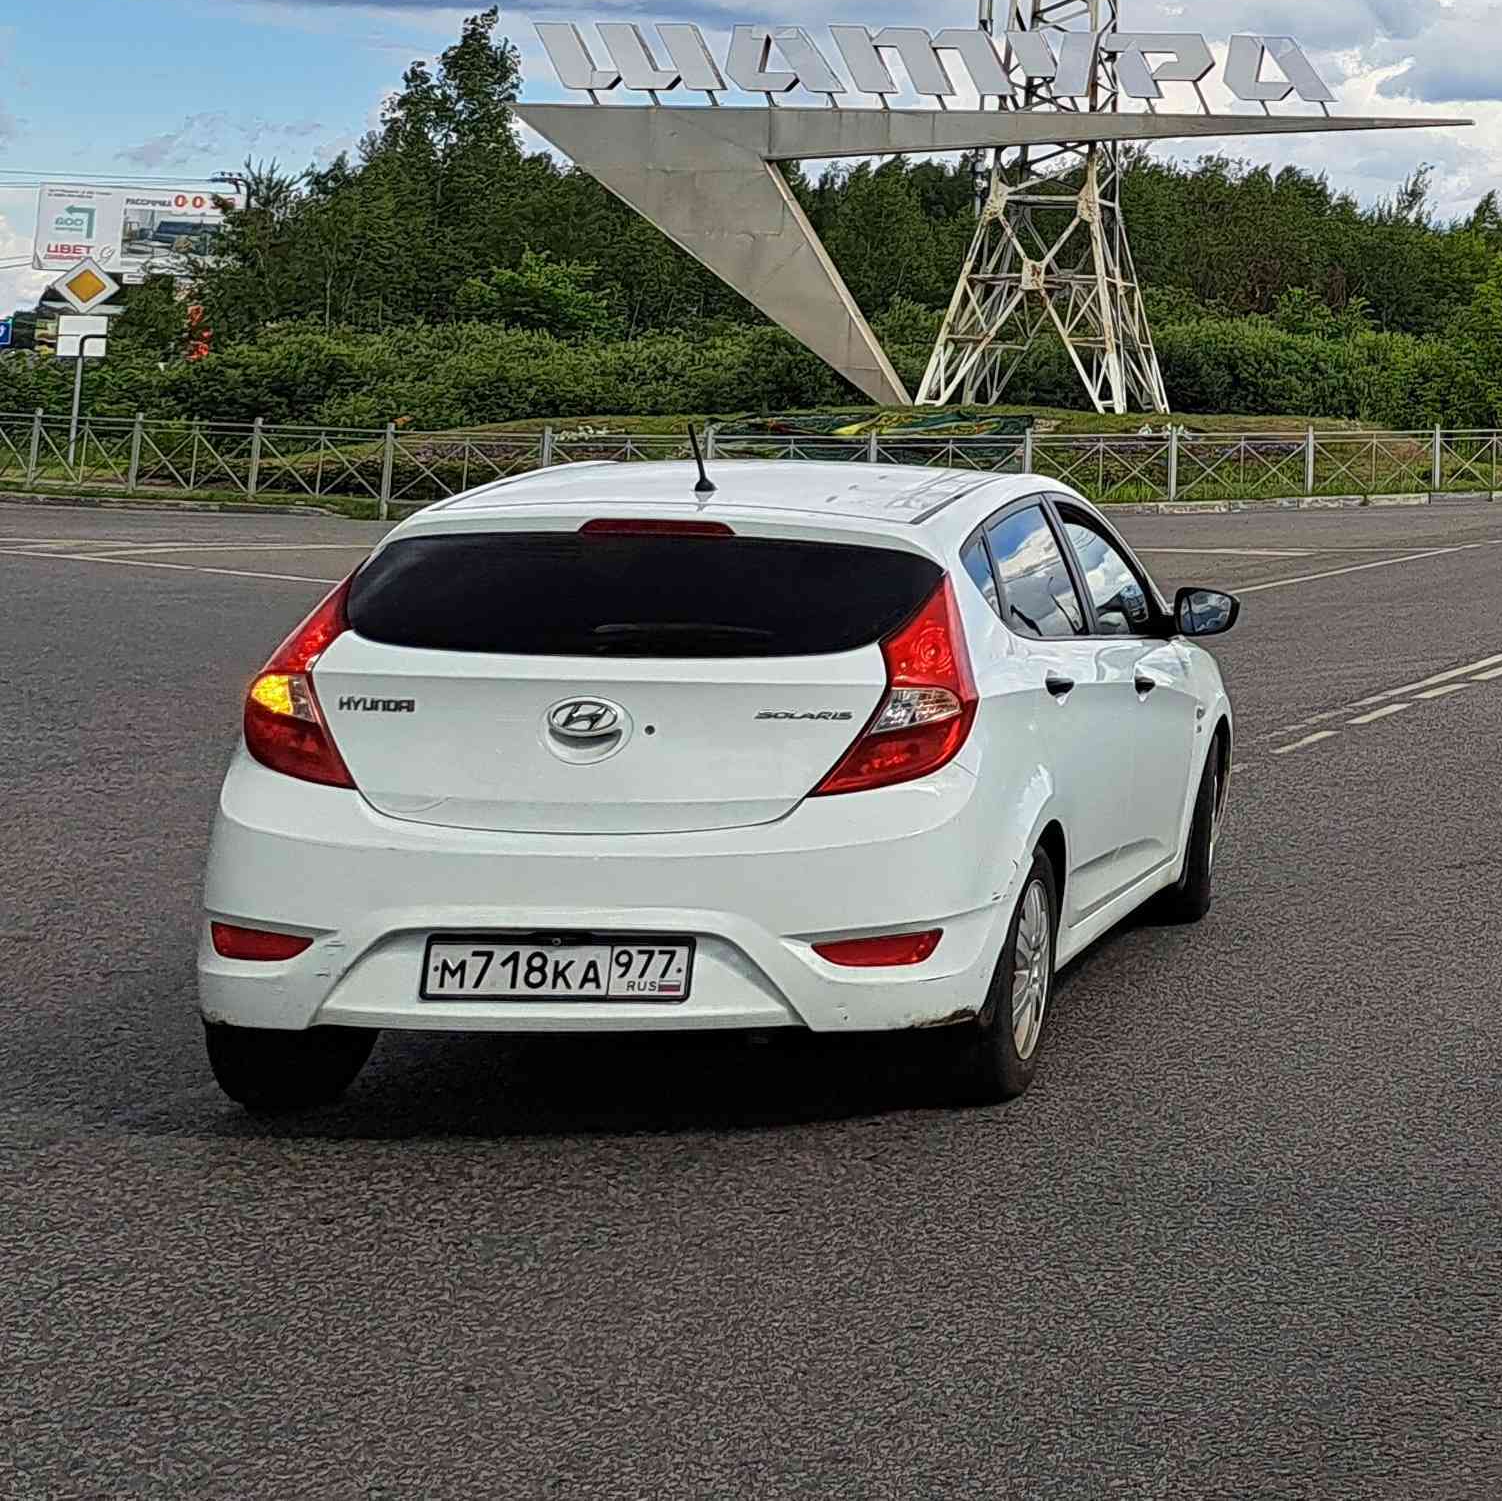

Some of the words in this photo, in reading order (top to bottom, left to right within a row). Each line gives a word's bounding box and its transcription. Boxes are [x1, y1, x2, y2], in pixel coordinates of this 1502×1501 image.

[338, 696, 415, 712] HYUNDAI
[754, 710, 853, 721] SOLARIS
[438, 950, 602, 990] М718КА
[614, 949, 677, 979] 977
[626, 981, 657, 992] RUS
